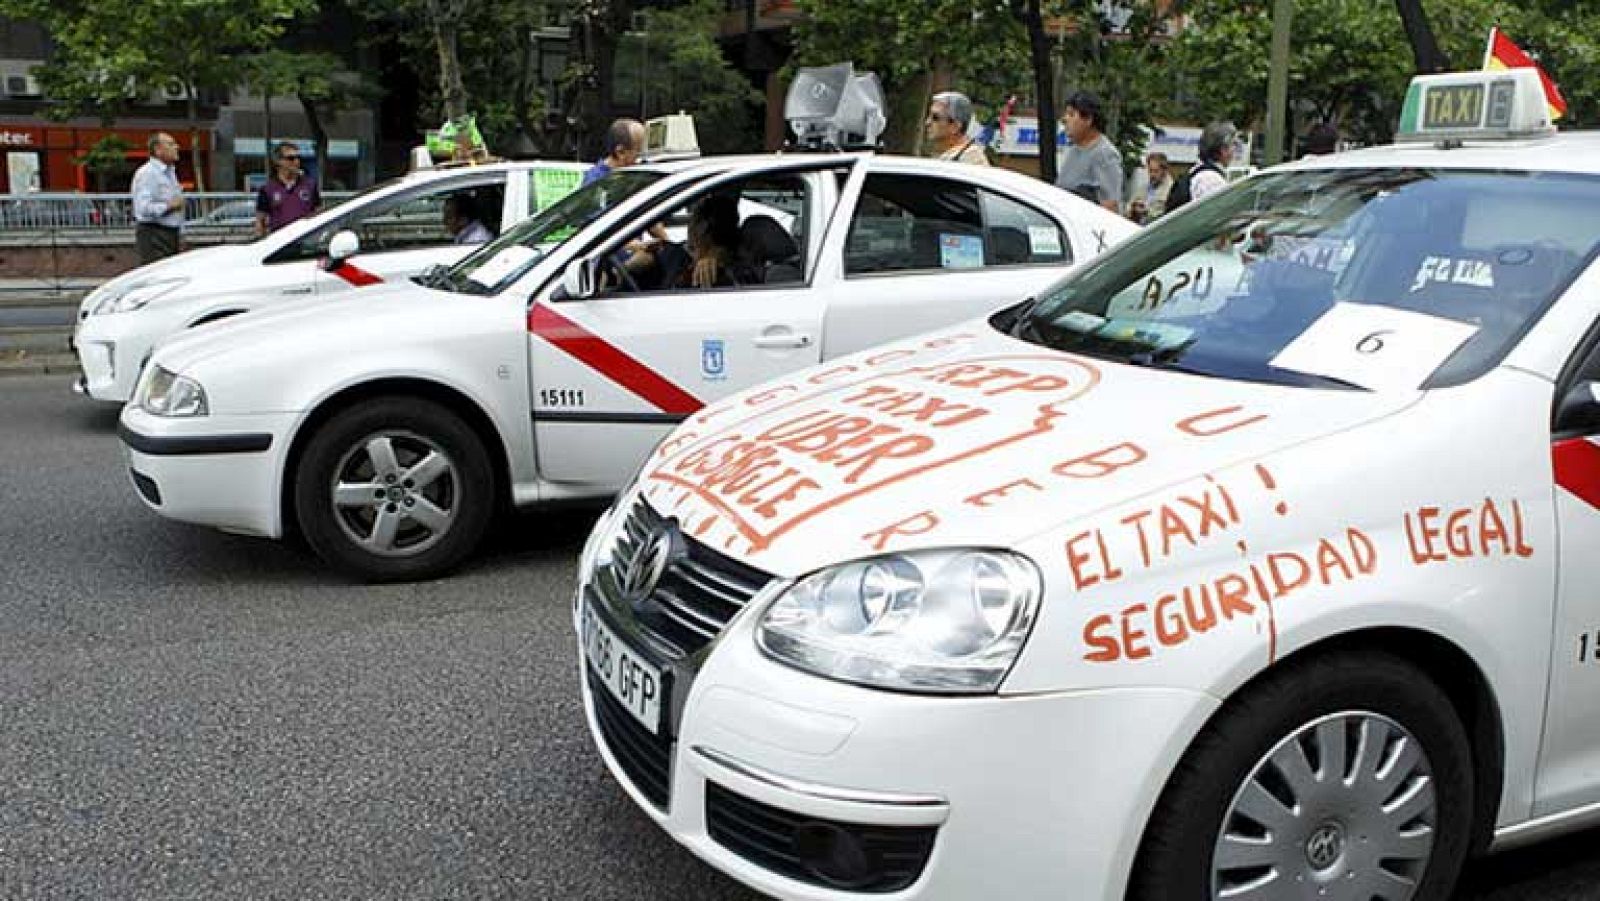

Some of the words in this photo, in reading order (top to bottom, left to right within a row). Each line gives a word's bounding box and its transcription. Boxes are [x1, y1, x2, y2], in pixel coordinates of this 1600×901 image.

[1428, 88, 1480, 123] TAXI
[1356, 329, 1396, 353] 6
[541, 390, 584, 406] 15111
[841, 386, 990, 426] TAXI
[756, 410, 935, 484] UBER
[1066, 529, 1122, 591] EL
[1083, 526, 1377, 661] SEGURIDAD
[1403, 496, 1534, 564] LEGAL
[619, 653, 654, 715] GFP
